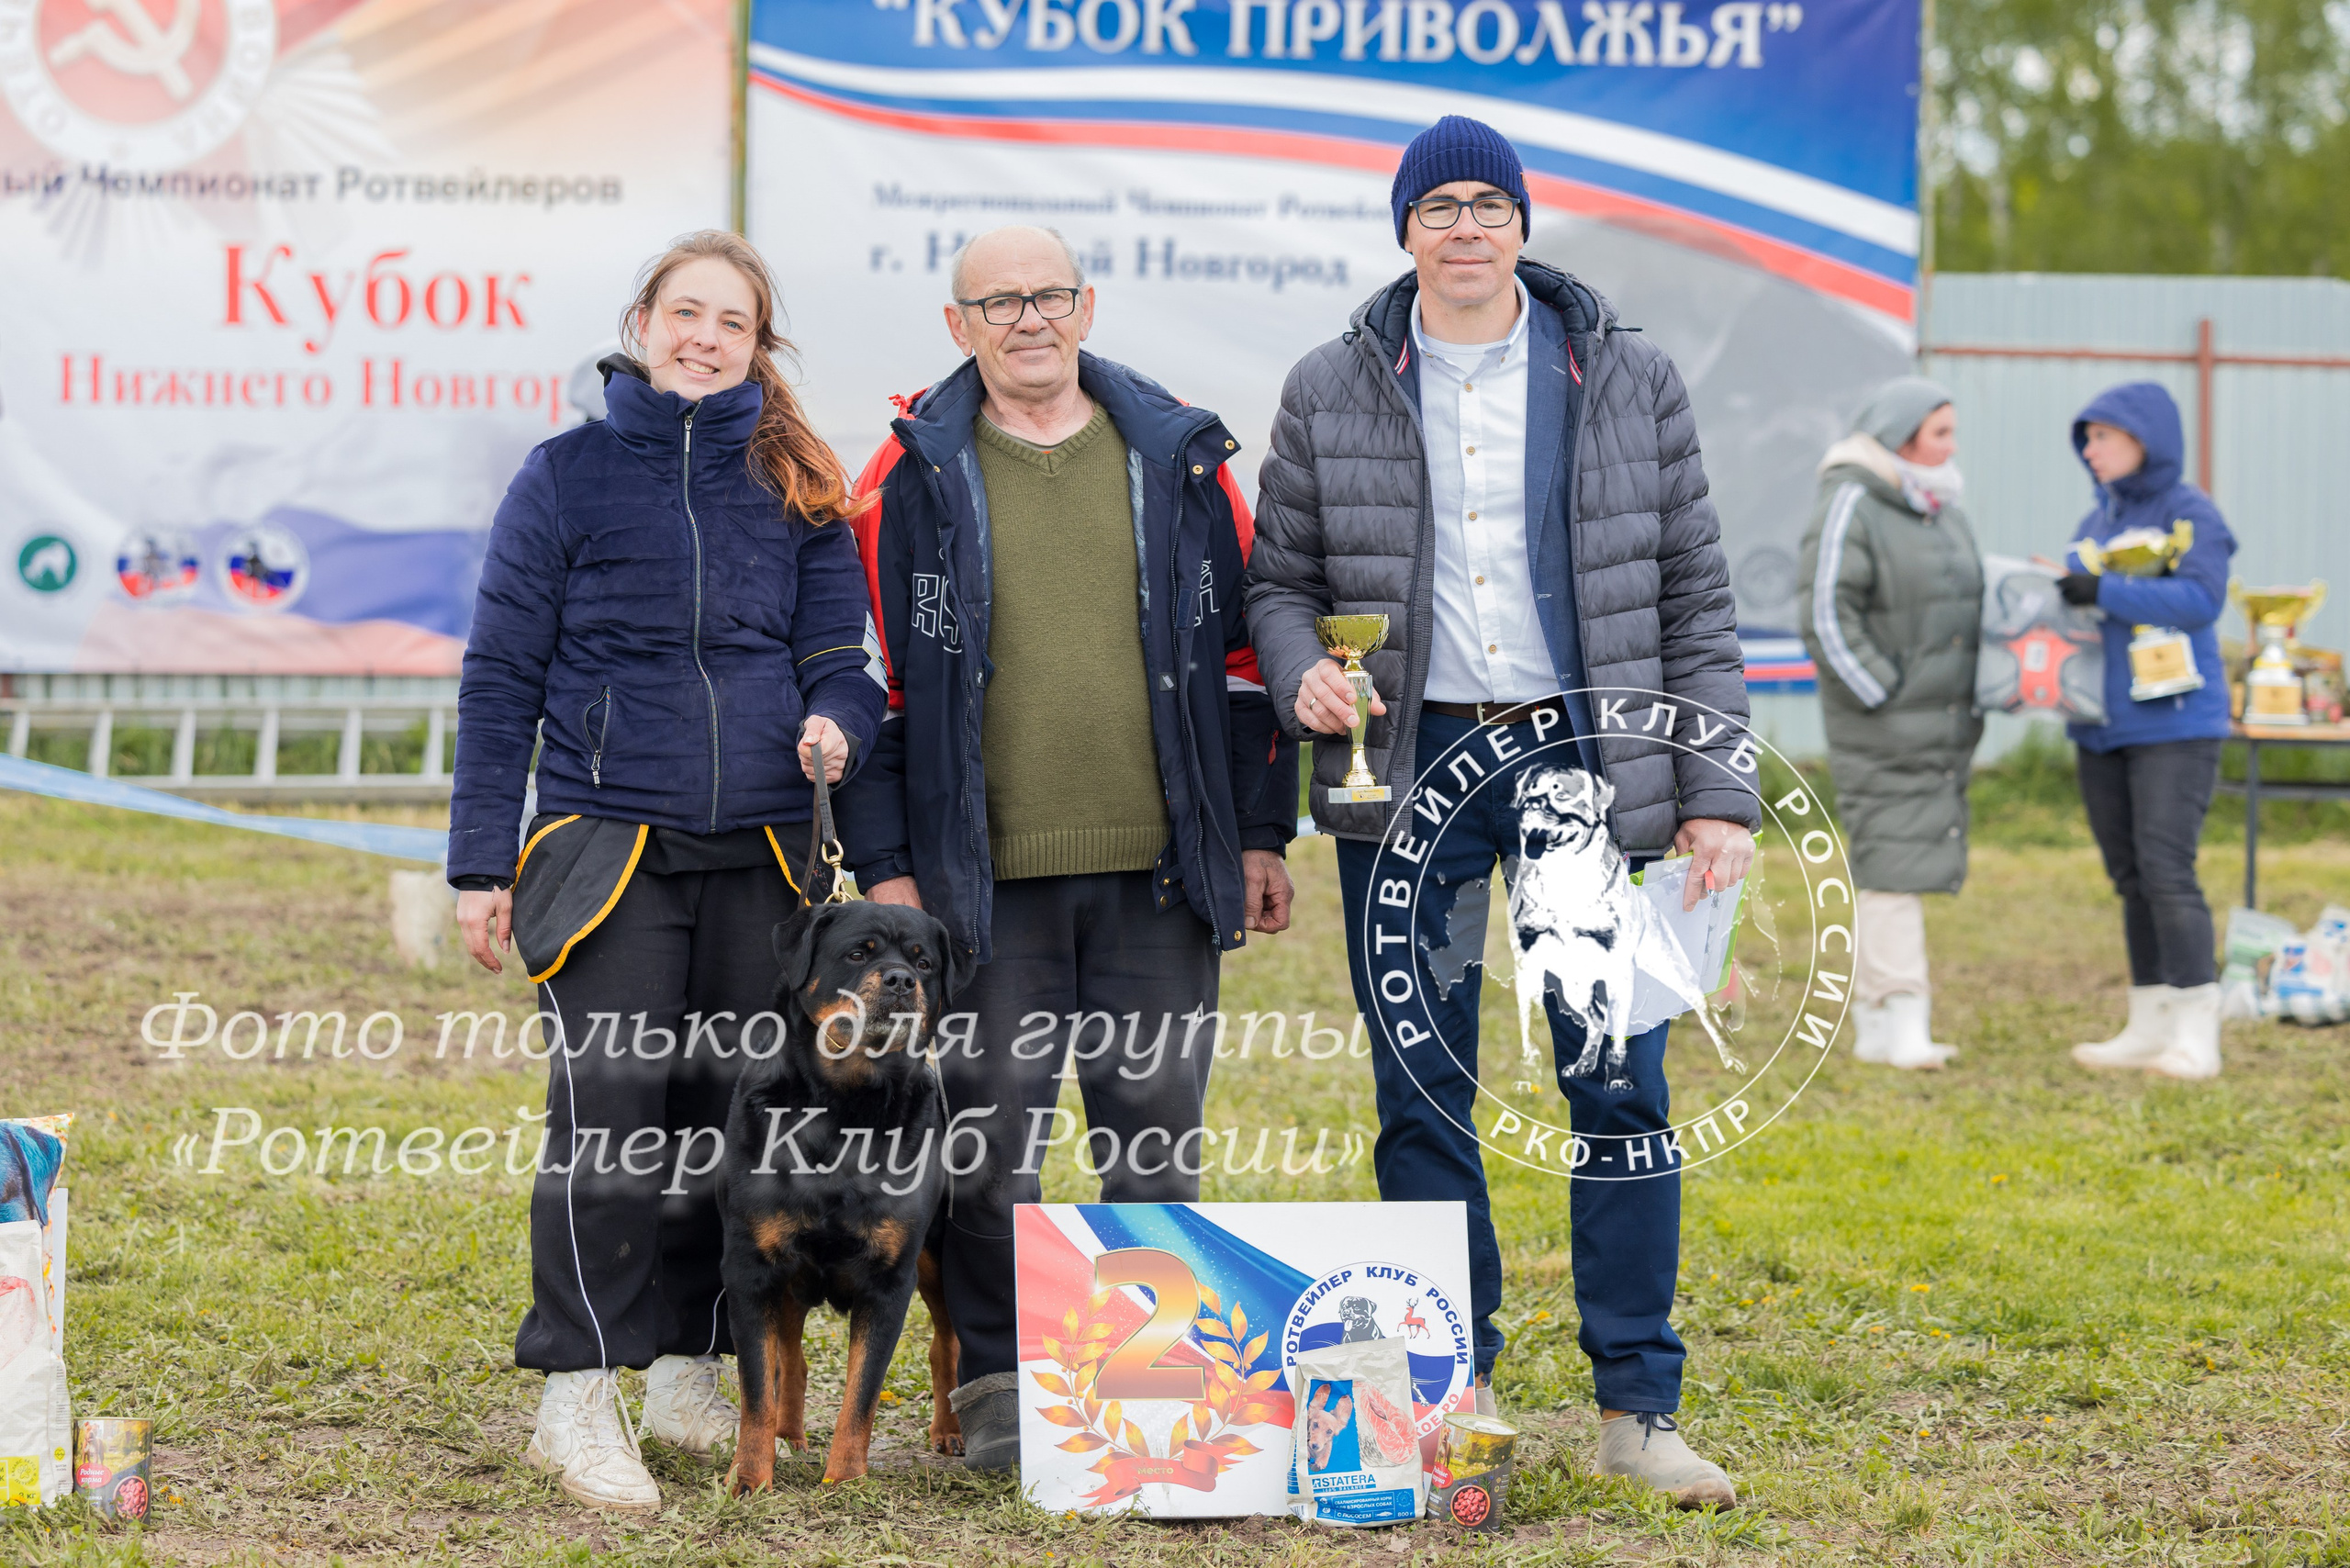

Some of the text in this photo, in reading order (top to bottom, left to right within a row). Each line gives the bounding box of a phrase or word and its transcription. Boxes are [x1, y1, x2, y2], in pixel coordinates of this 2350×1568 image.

[79, 162, 321, 202] Чемпионат
[334, 165, 624, 207] Ротвейлеров
[1134, 235, 1351, 292] Новгород
[219, 241, 533, 354] Кубок
[60, 352, 333, 408] Нижнего
[1093, 1248, 1206, 1401] 2
[1286, 1266, 1469, 1367] РОТВЕЙЛЕР КЛУБ РОССИИ
[1347, 1502, 1376, 1510] ВЗРОСЛЫХ
